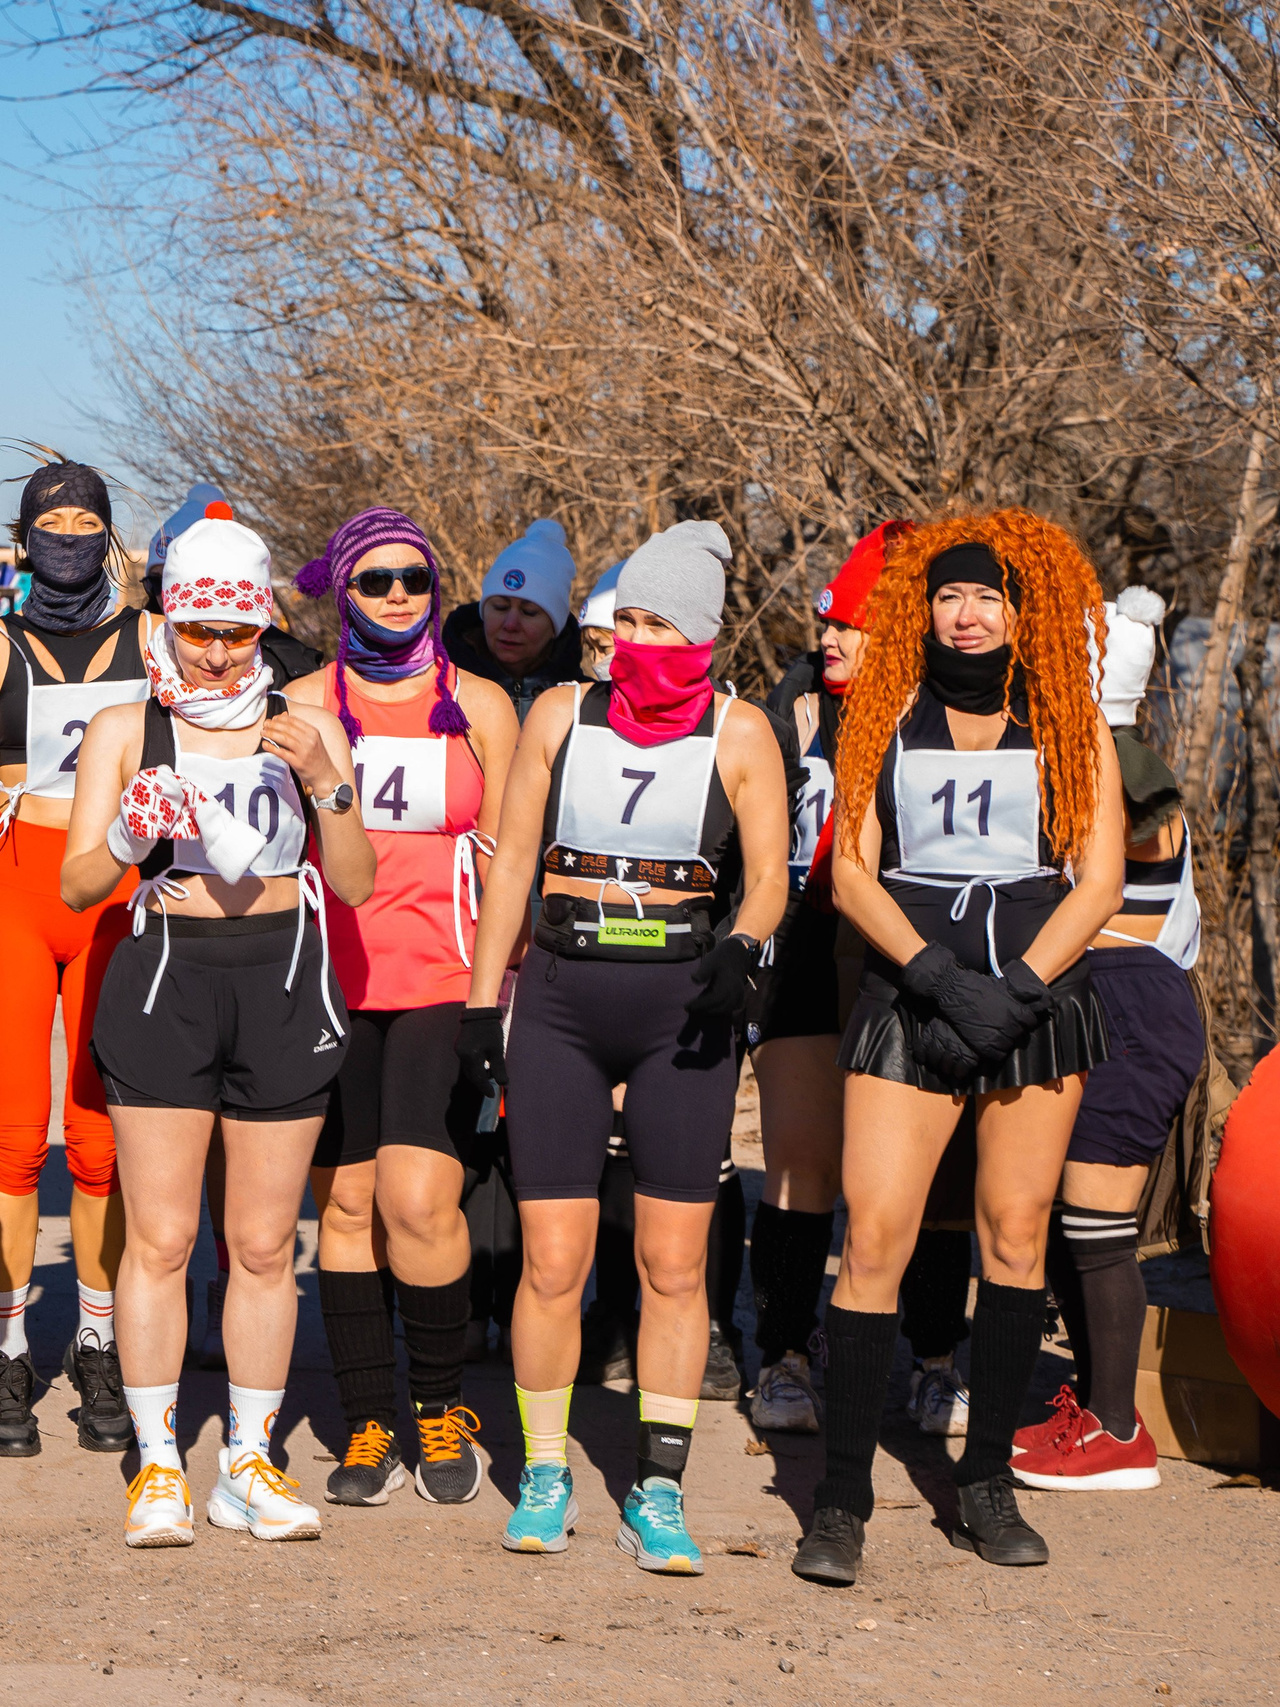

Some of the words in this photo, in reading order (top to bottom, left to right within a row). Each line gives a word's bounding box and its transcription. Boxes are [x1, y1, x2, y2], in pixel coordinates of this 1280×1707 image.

[214, 783, 280, 845] 10
[620, 767, 656, 825] 7
[931, 779, 992, 836] 11
[605, 926, 659, 938] ULTRA100
